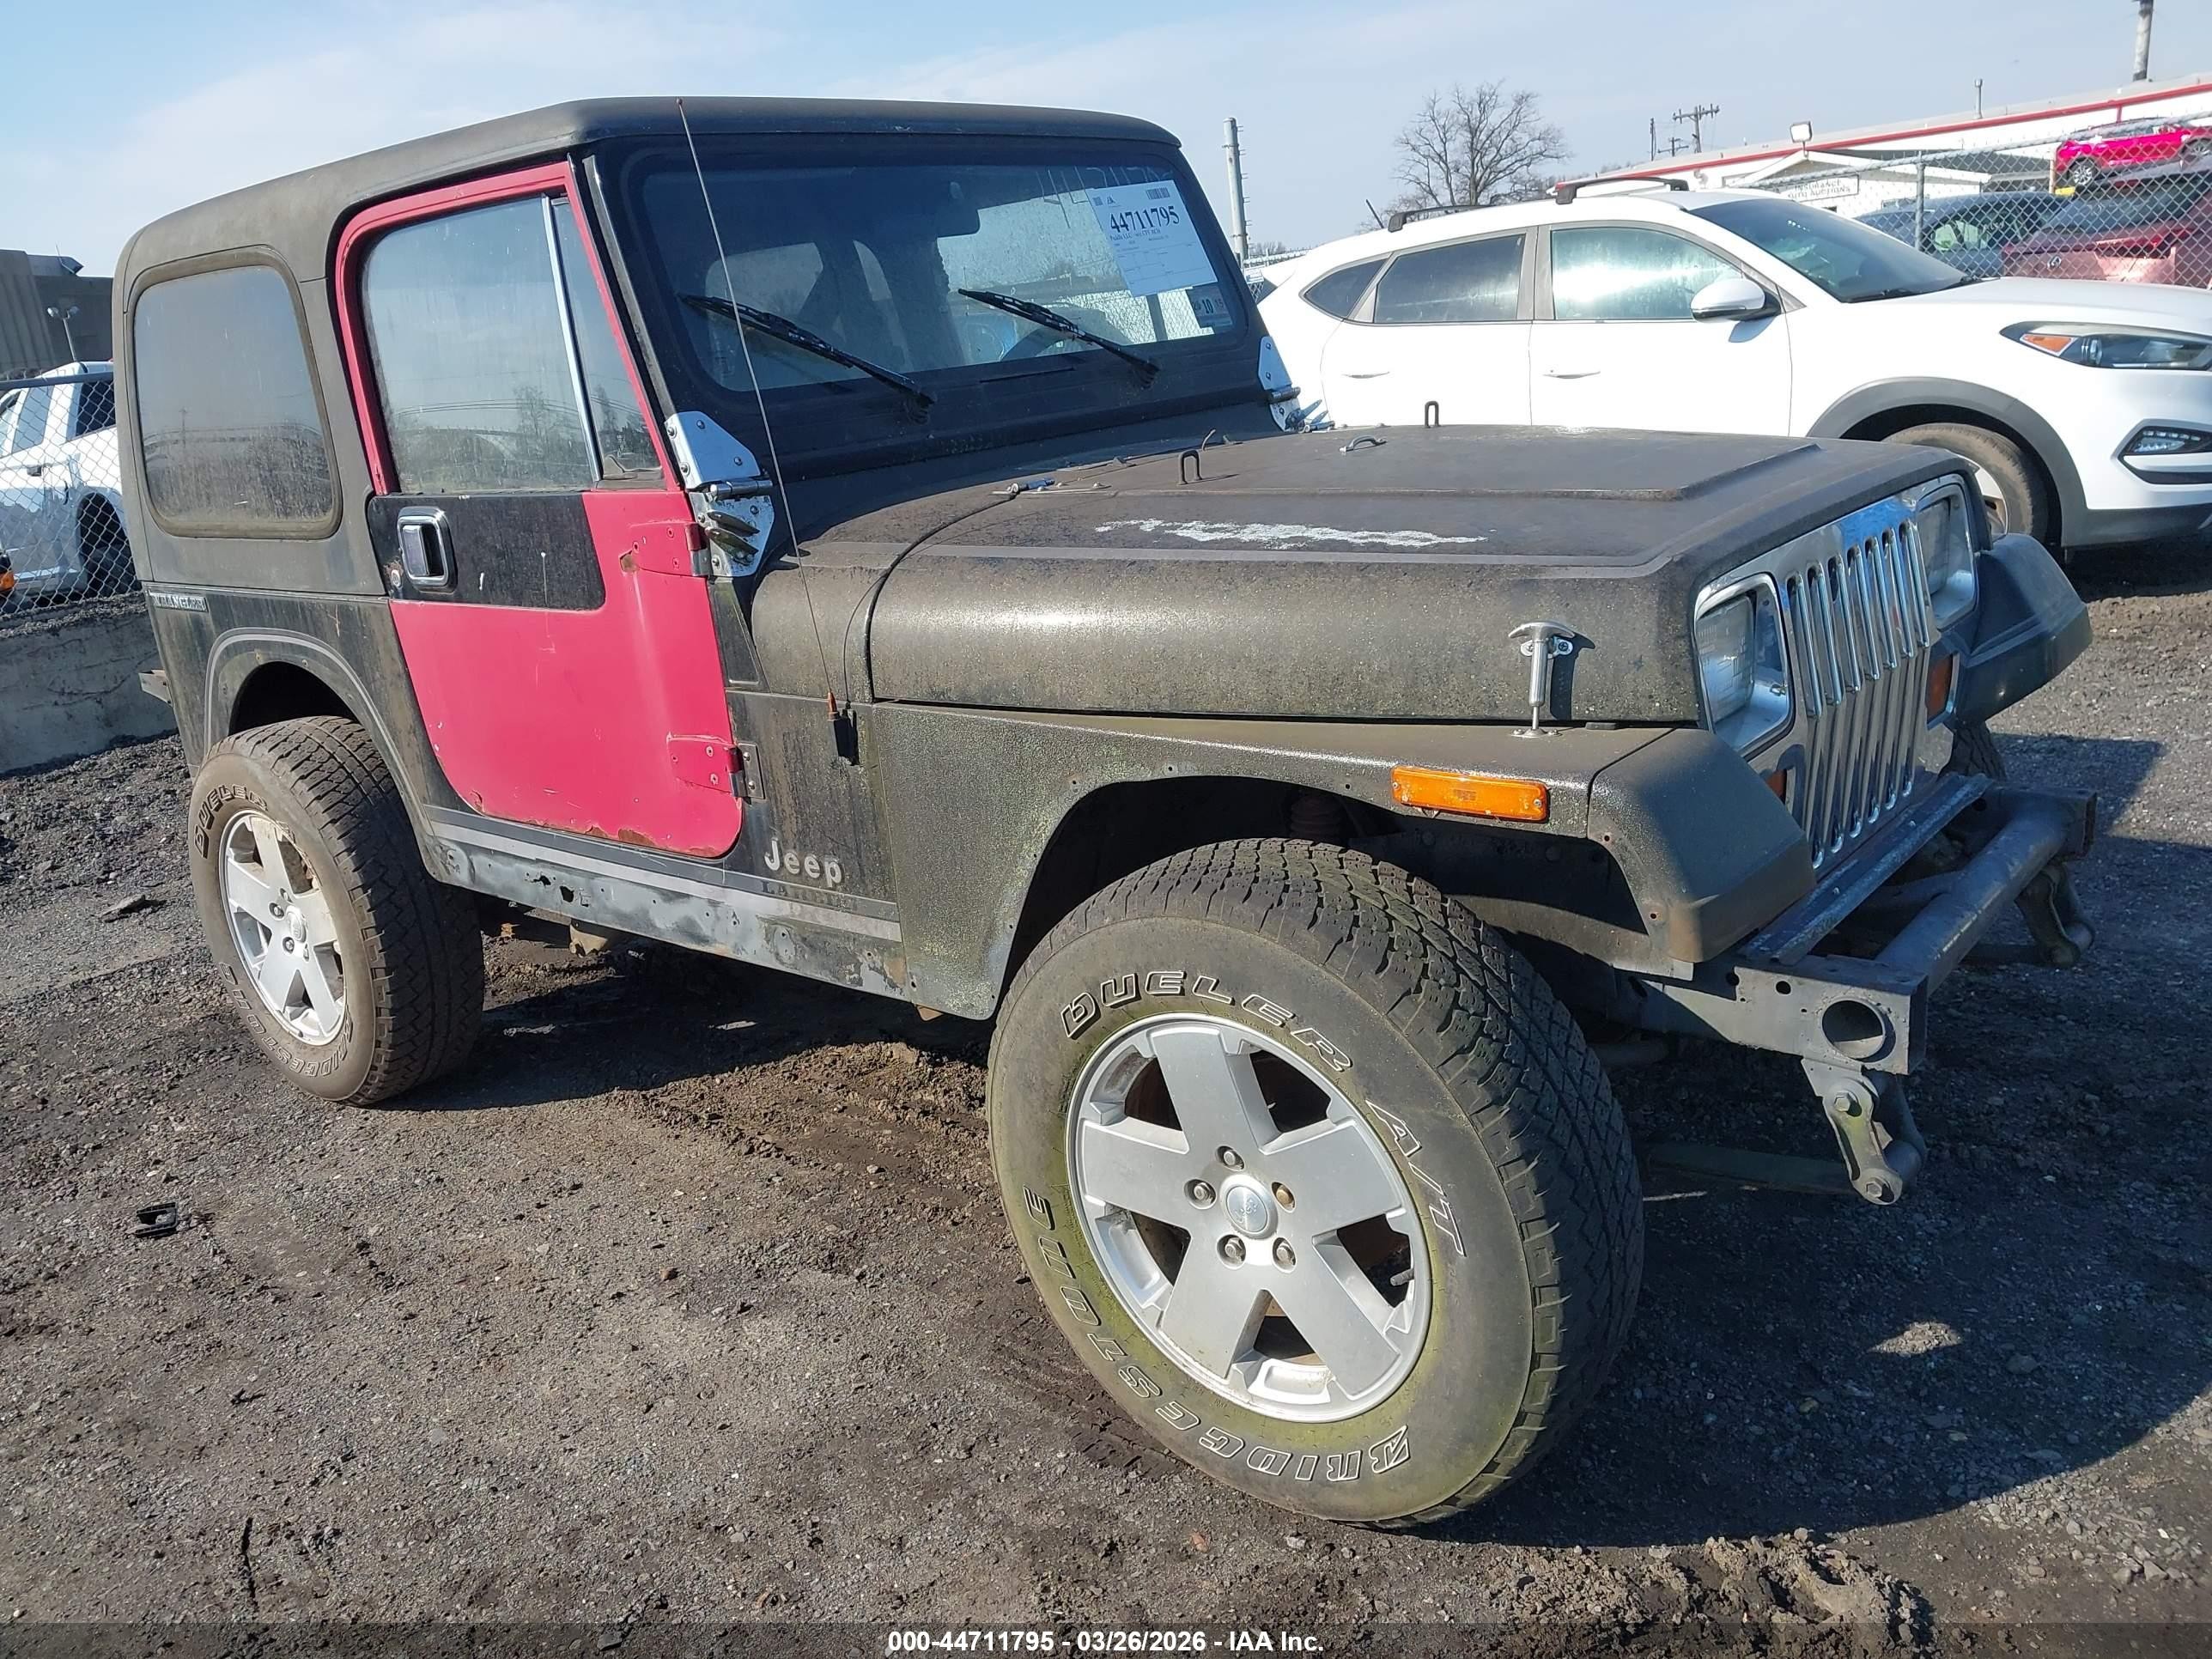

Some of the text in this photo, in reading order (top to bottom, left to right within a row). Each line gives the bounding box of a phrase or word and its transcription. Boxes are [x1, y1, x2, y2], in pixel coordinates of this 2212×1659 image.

[1110, 205, 1180, 233] 44711795
[194, 784, 268, 859] DUELER
[764, 837, 842, 888] Jeep
[1060, 971, 1467, 1257] DUELER A/T
[1023, 1184, 1410, 1482] BRIDGESTONE
